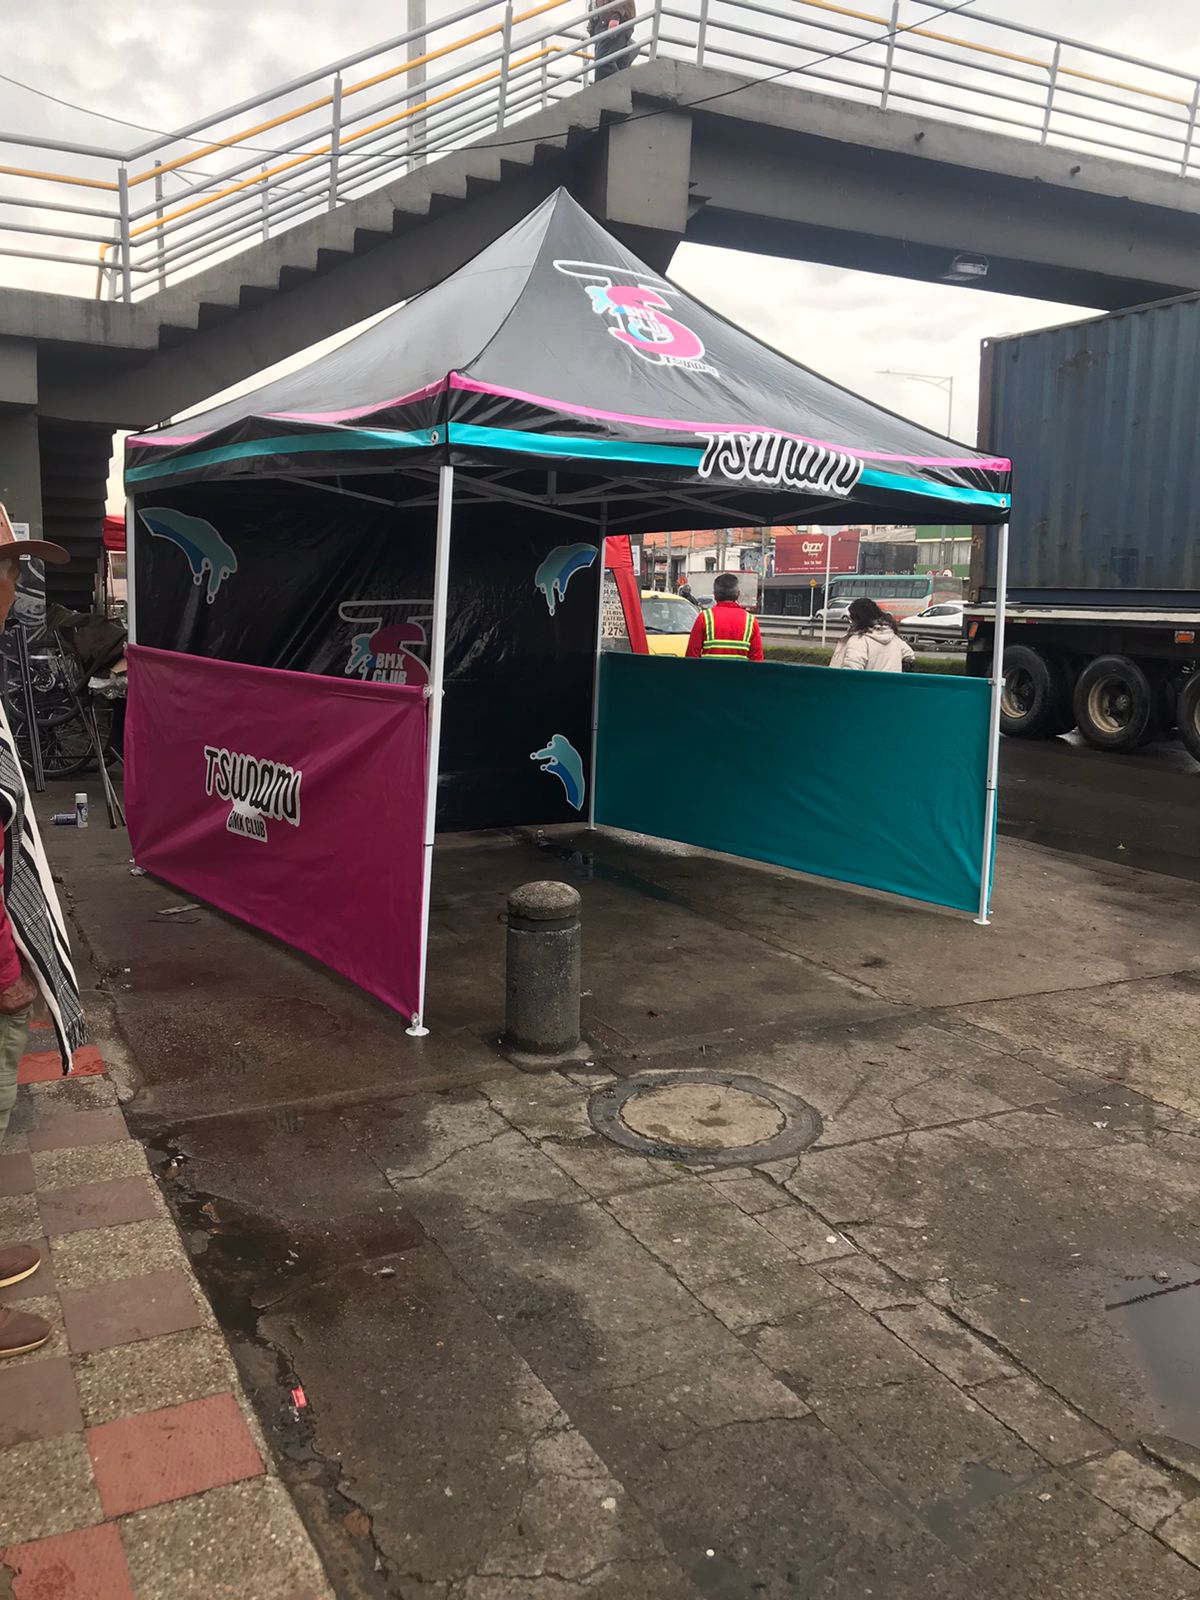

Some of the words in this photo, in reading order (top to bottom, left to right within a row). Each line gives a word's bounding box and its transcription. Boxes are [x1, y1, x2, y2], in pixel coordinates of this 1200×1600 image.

[376, 653, 406, 669] BMX
[372, 669, 407, 685] CLUB
[245, 816, 266, 838] CLUB
